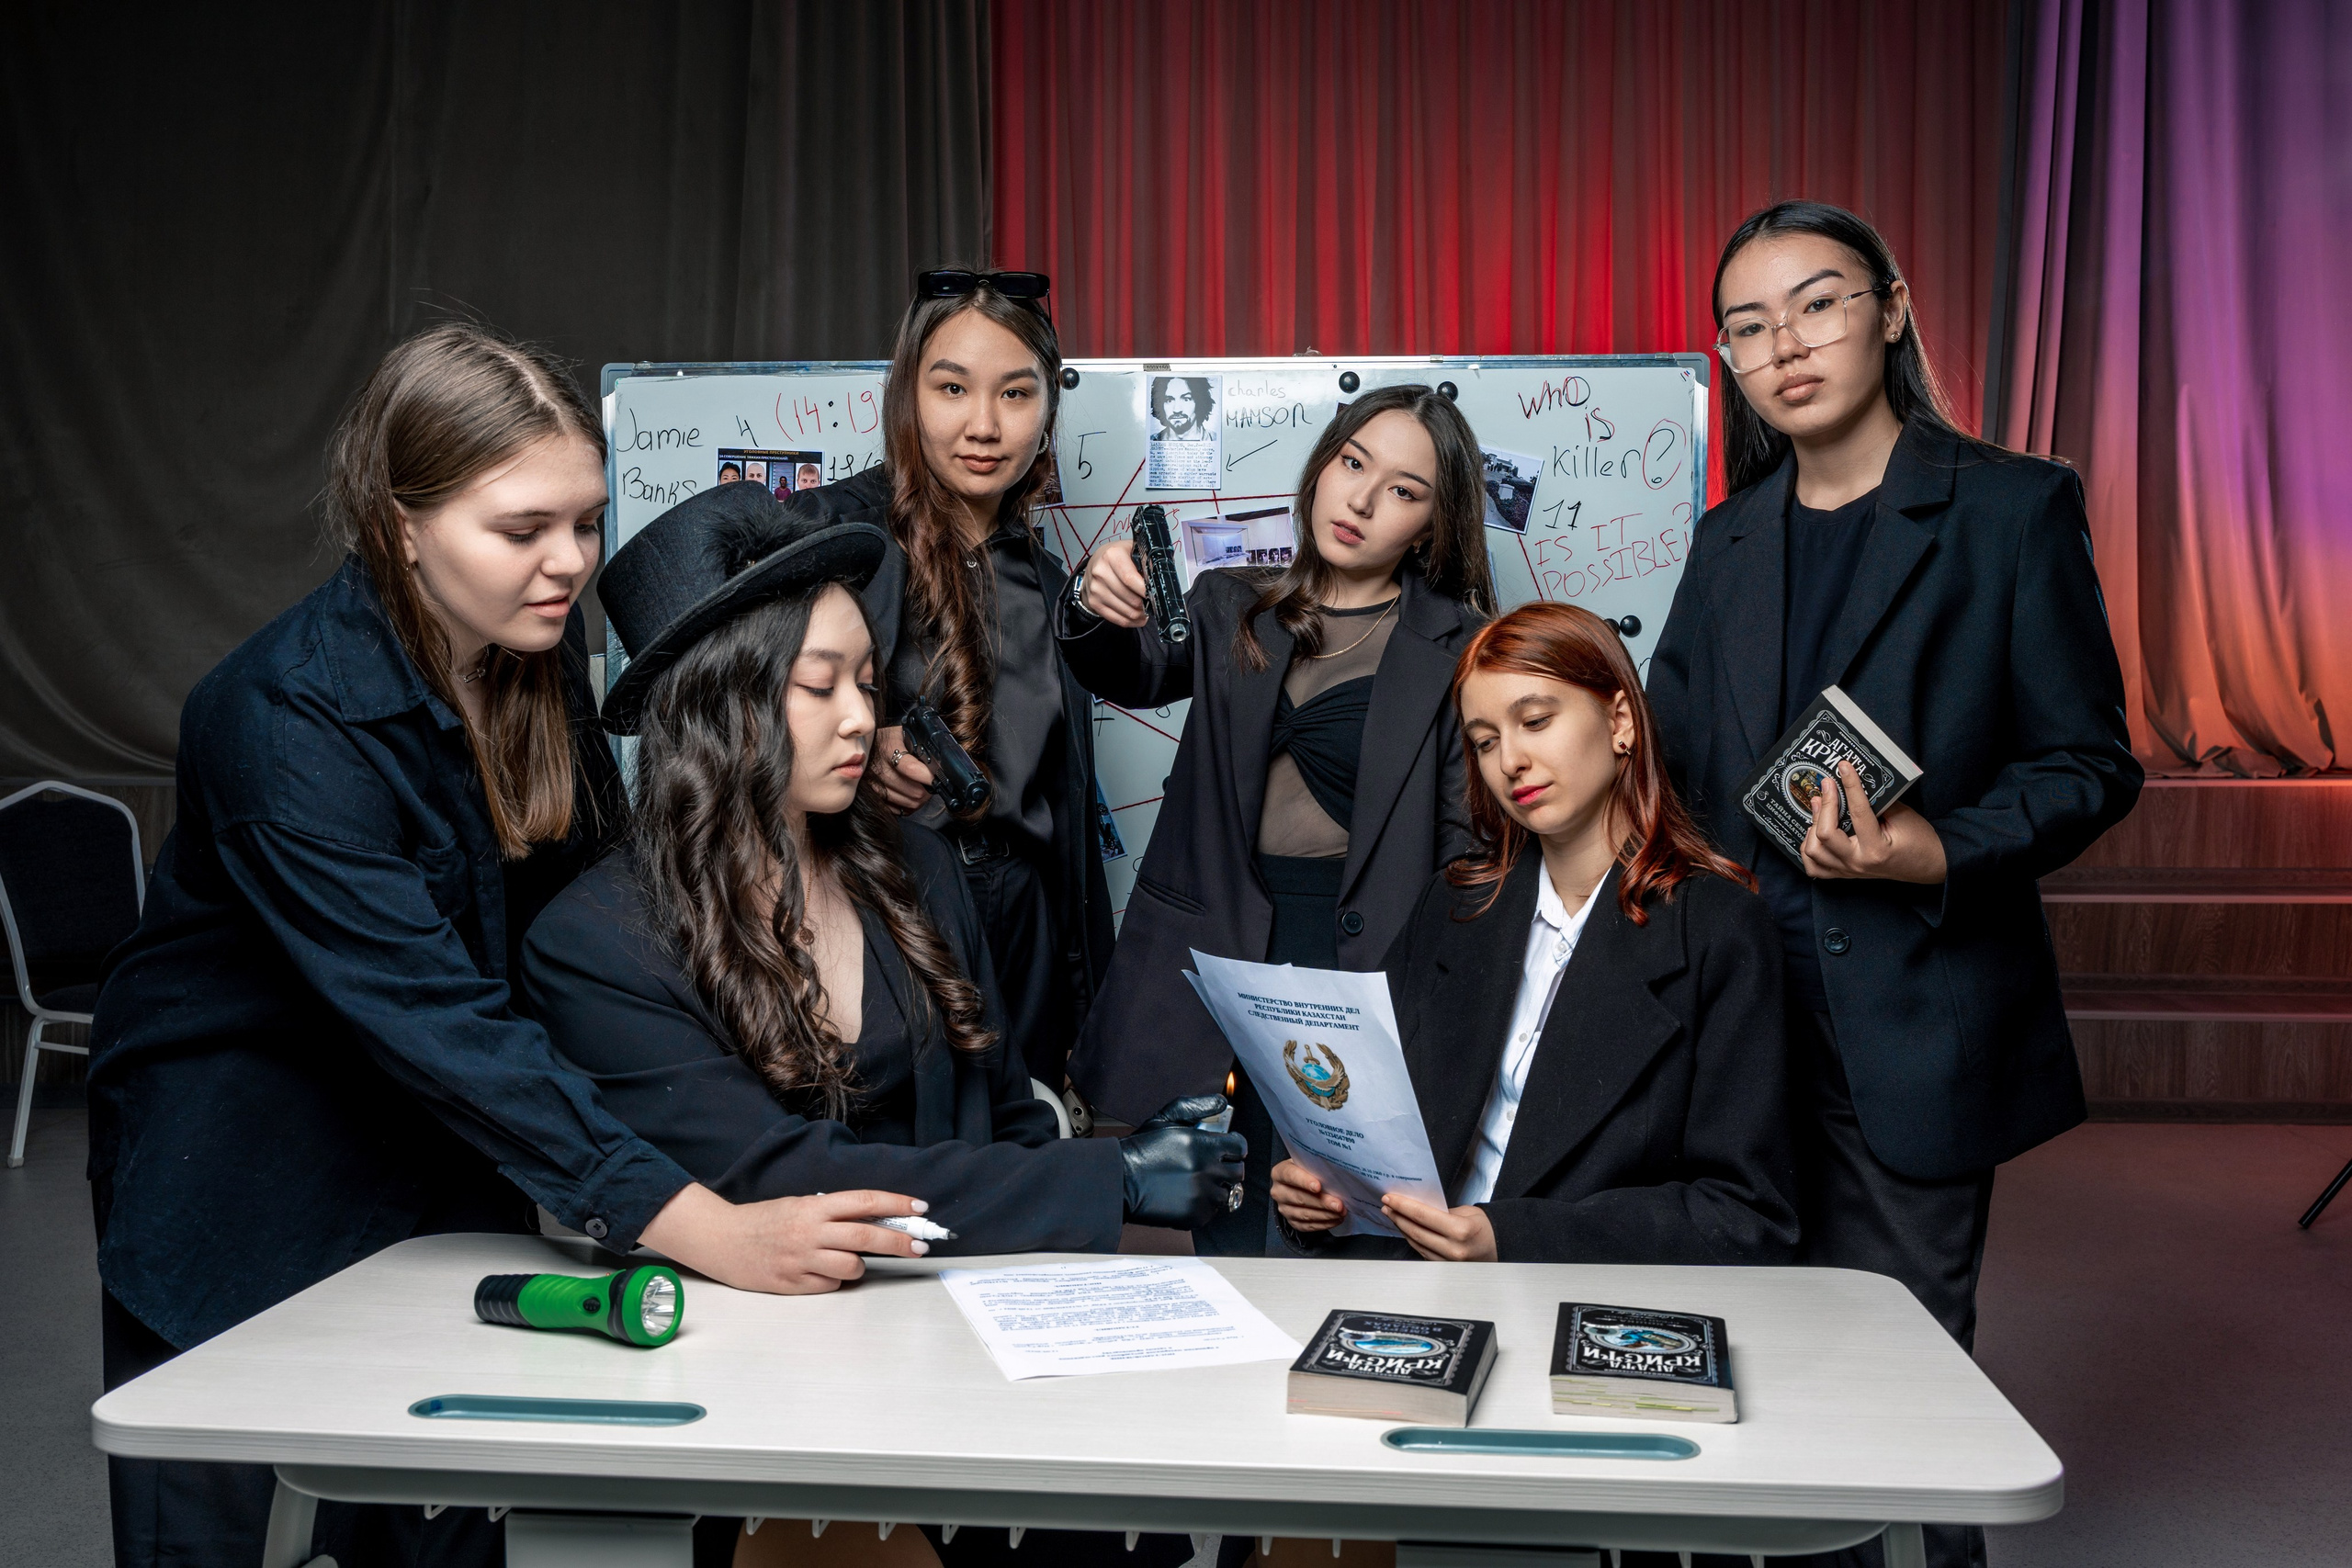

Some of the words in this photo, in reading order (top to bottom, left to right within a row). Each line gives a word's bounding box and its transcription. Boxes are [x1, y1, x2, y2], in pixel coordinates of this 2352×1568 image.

[775, 390, 878, 442] (14:19
[616, 408, 704, 452] Jamie
[1535, 536, 1573, 567] IS
[1590, 513, 1643, 551] IT
[1828, 738, 1867, 776] АГАТА
[1770, 798, 1792, 820] ТАЙНА
[1238, 992, 1293, 1007] МИНИСТЕРСТВО
[1294, 1001, 1344, 1012] ВНУТРЕННИХ
[1254, 1003, 1301, 1016] РЕСПУБЛИКИ
[1302, 1011, 1346, 1021] КАЗАХСТАН
[1248, 1010, 1303, 1025] СЛЕДСТВЕННЫЙ
[1305, 1020, 1360, 1031] ДЕПАРТАМЕНТ
[1306, 1117, 1345, 1134] УГОЛОВНОЕ
[1345, 1130, 1364, 1139] ДЕЛО
[1327, 1139, 1341, 1147] ТОМ
[1327, 1350, 1443, 1369] КРИСТИ
[1583, 1347, 1702, 1367] КРИСТИ
[1609, 1361, 1675, 1372] АГАТА
[1347, 1362, 1411, 1374] АГАТА
